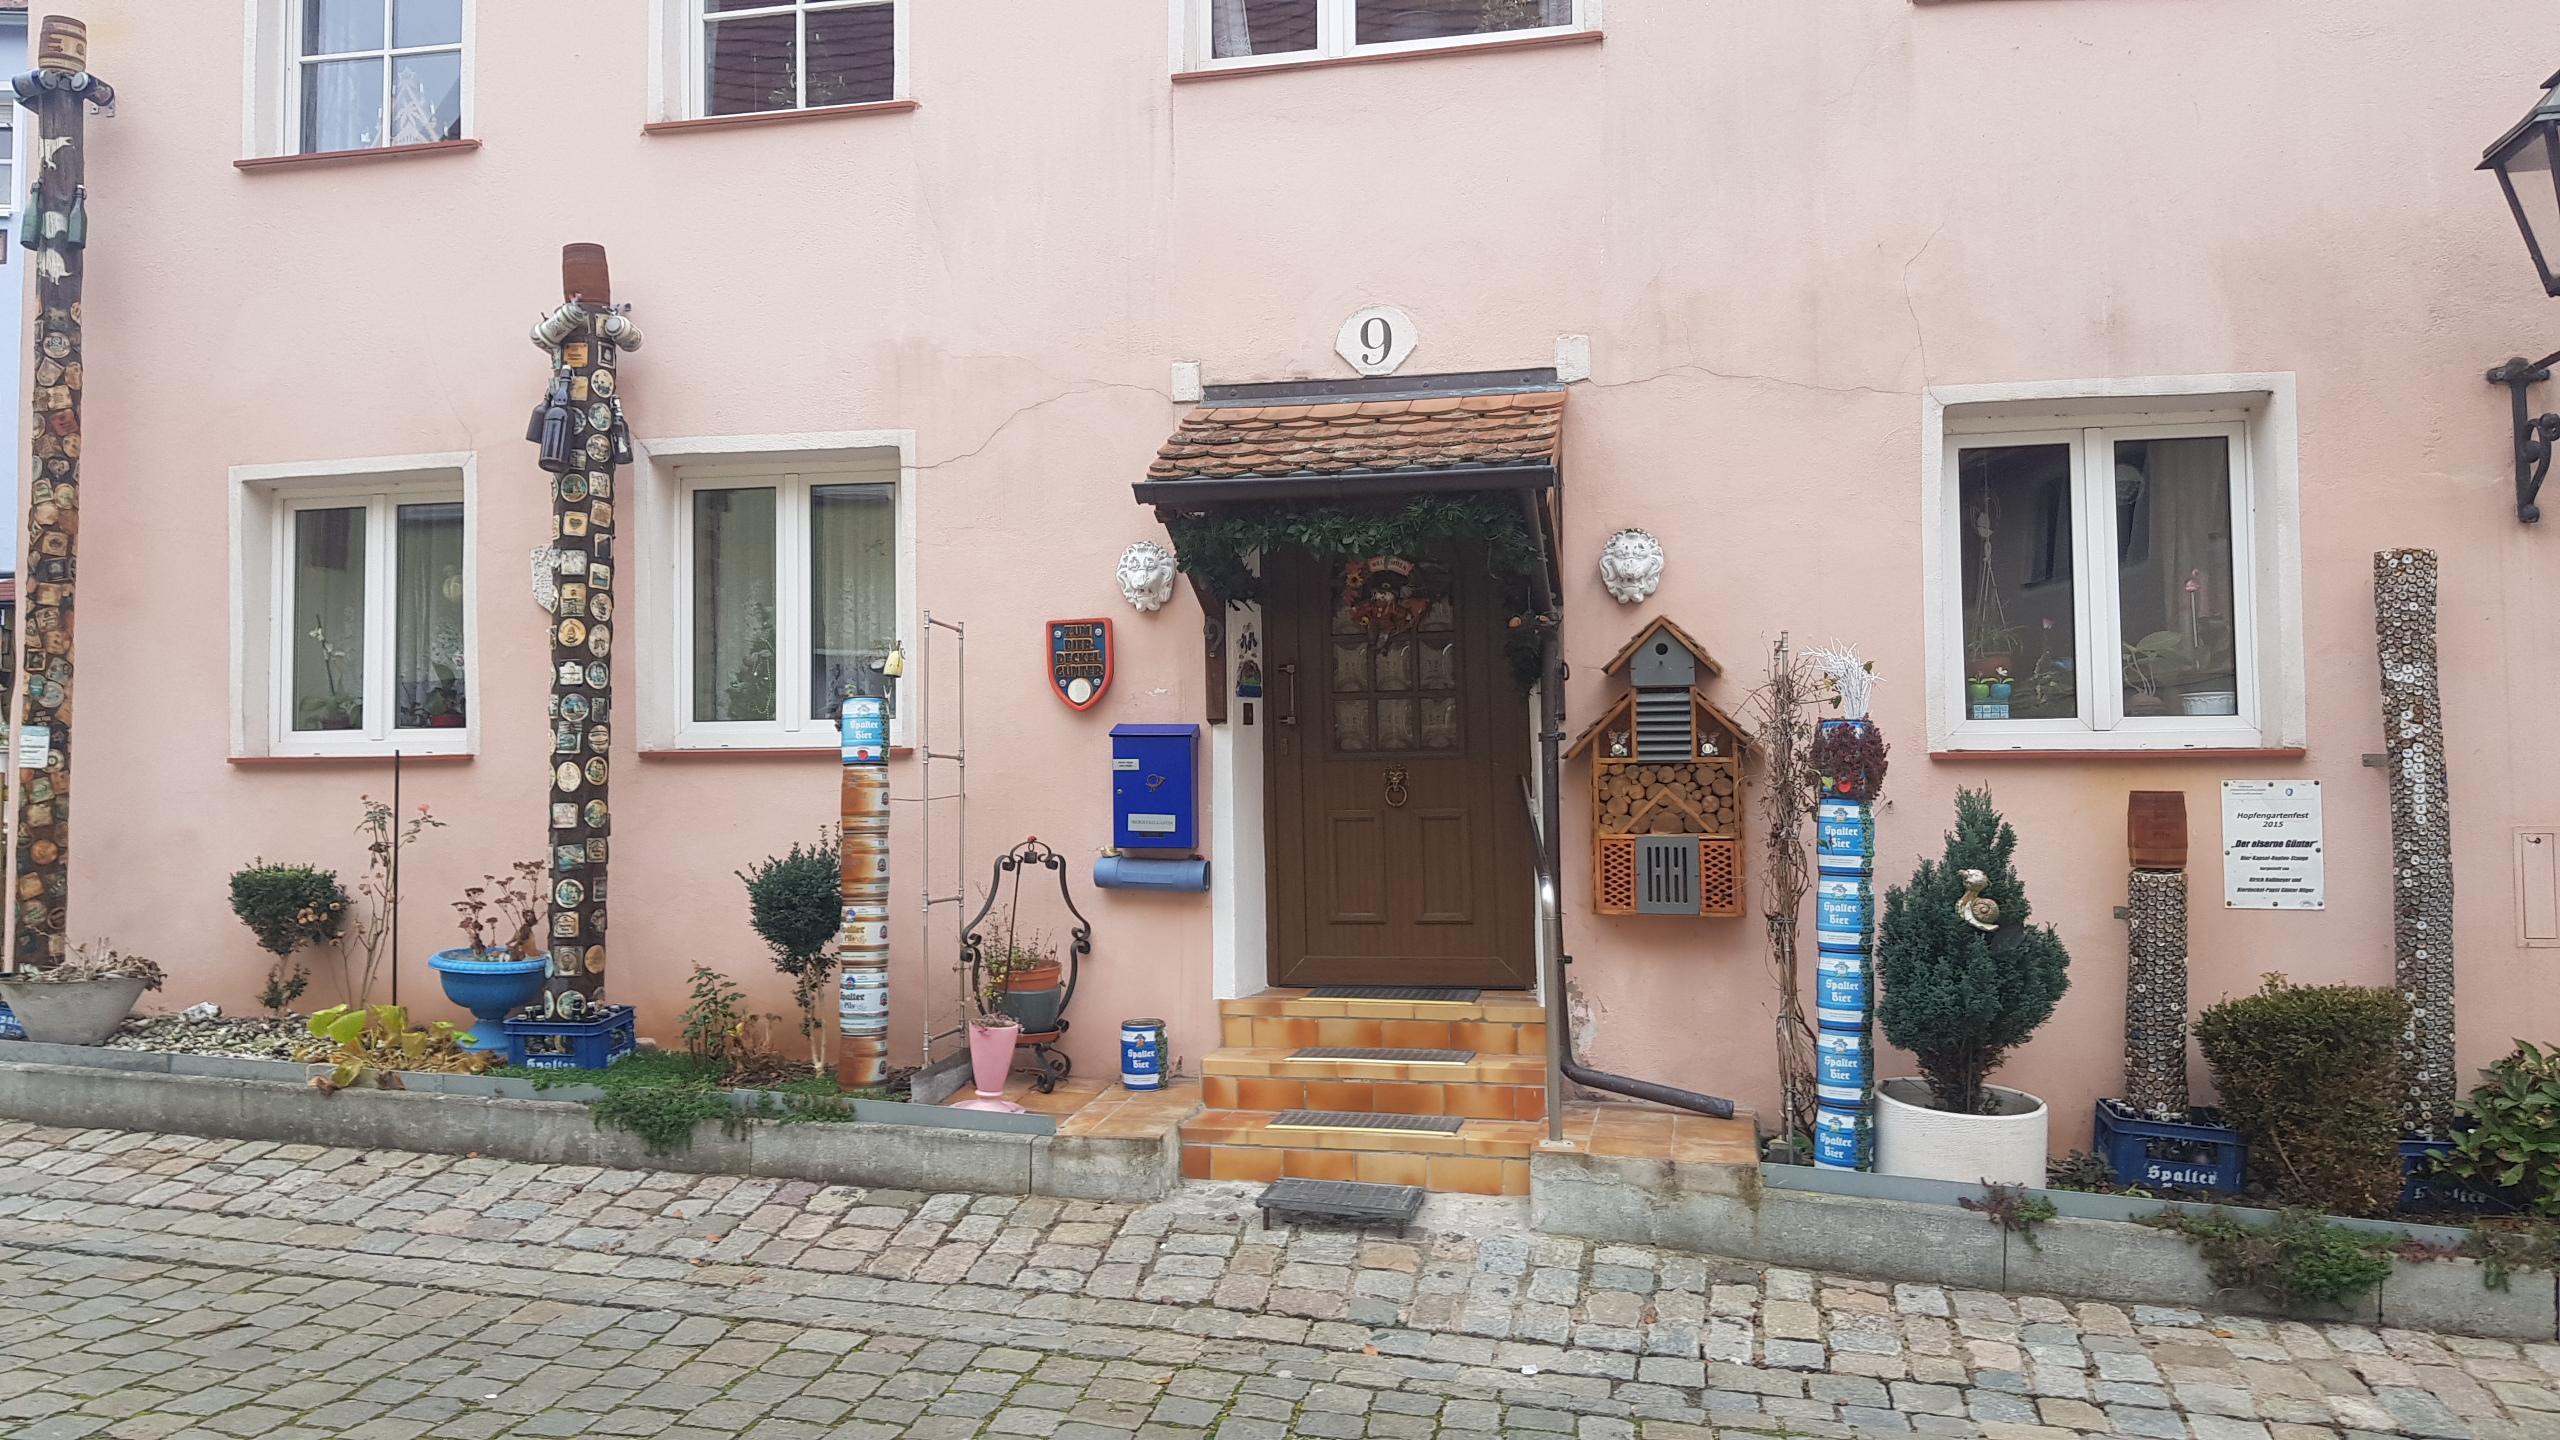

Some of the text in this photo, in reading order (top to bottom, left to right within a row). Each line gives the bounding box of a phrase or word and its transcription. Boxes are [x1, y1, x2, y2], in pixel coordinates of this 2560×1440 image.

[1360, 317, 1392, 366] 9
[1064, 625, 1092, 637] ZUM
[1056, 650, 1101, 664] DECKEL
[2237, 812, 2309, 820] Hopfengartenfest
[1824, 902, 1857, 914] Spalter
[1829, 914, 1849, 925] Bier
[1826, 979, 1859, 992] Spalter
[1831, 991, 1852, 1003] Bier
[1133, 1059, 1149, 1069] Bier
[1824, 1056, 1858, 1069] Spalter
[1830, 1068, 1850, 1080] Bier
[1820, 1133, 1852, 1147] Spalter
[1824, 1145, 1844, 1159] Bier
[2147, 1164, 2217, 1185] Spalter
